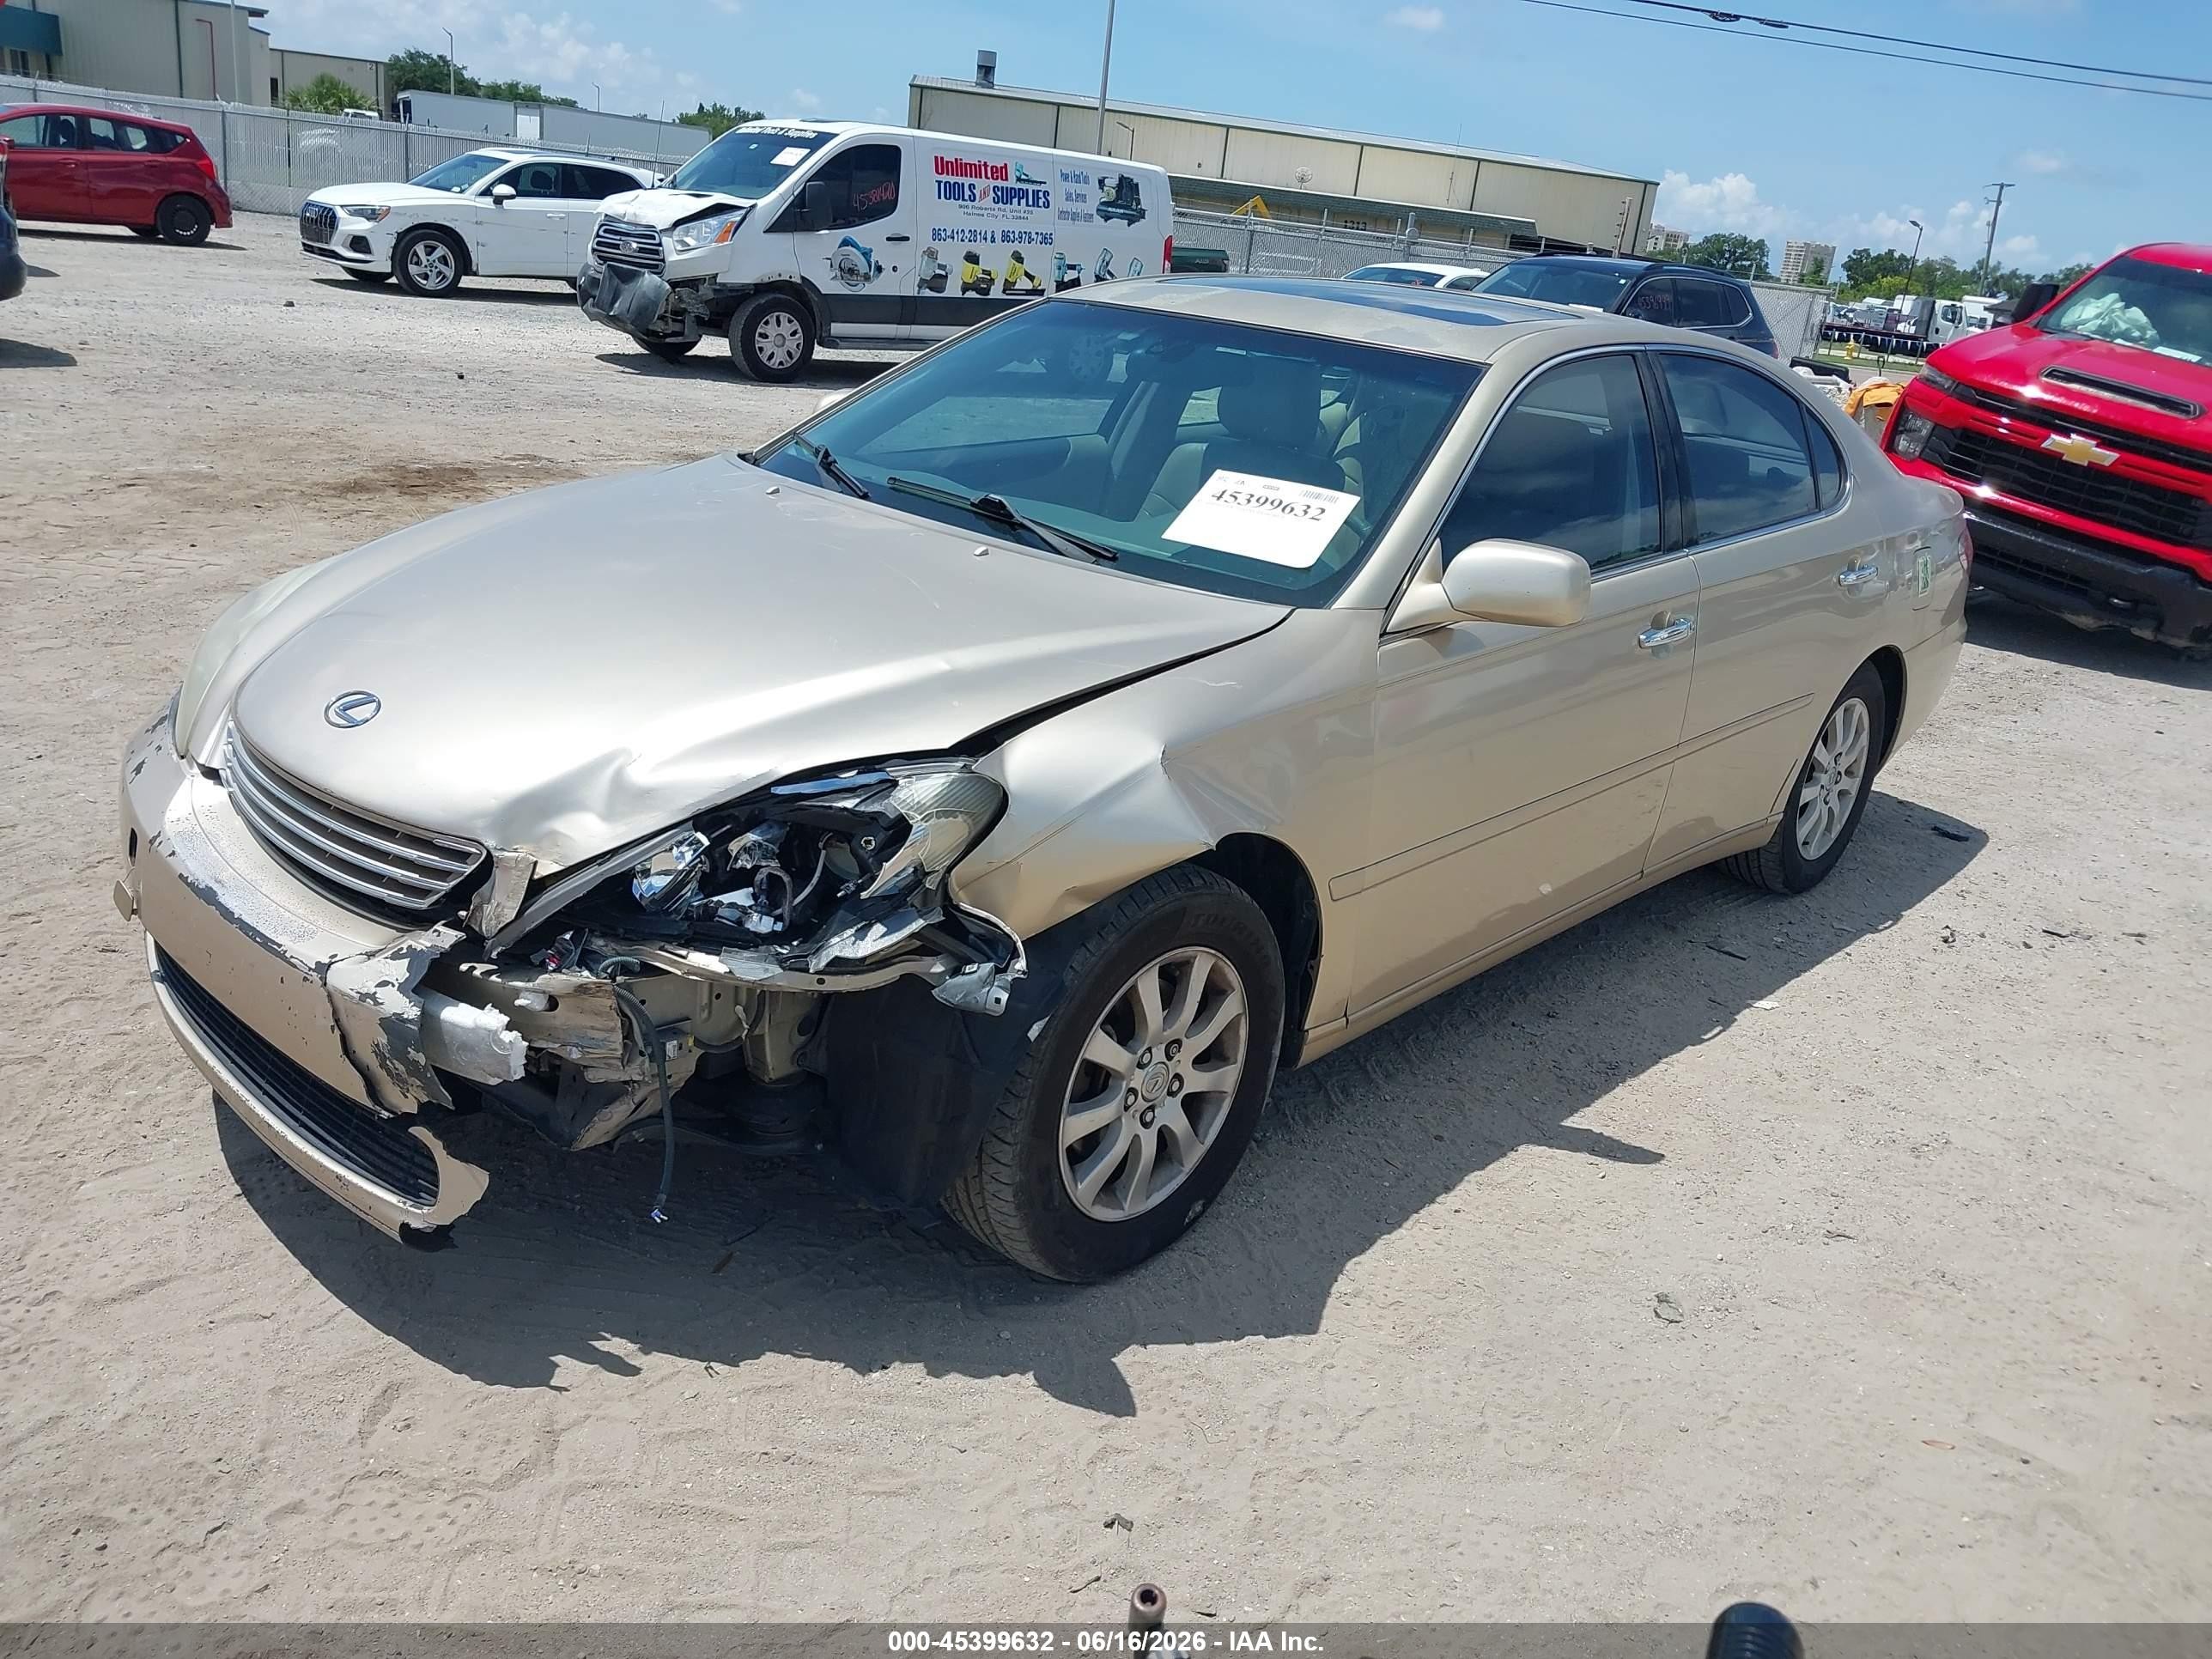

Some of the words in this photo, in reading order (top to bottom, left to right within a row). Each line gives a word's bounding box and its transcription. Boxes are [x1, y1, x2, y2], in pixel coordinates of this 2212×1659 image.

[933, 155, 1009, 182] Unlimited
[935, 179, 976, 203] TOOLS
[978, 184, 991, 203] AND
[992, 185, 1051, 210] SUPPLIES
[932, 228, 988, 243] 863-412-2814
[990, 229, 997, 244] &
[1000, 229, 1054, 246] 863-978-7365
[1344, 220, 1367, 230] 1313
[1212, 489, 1326, 521] 45399632
